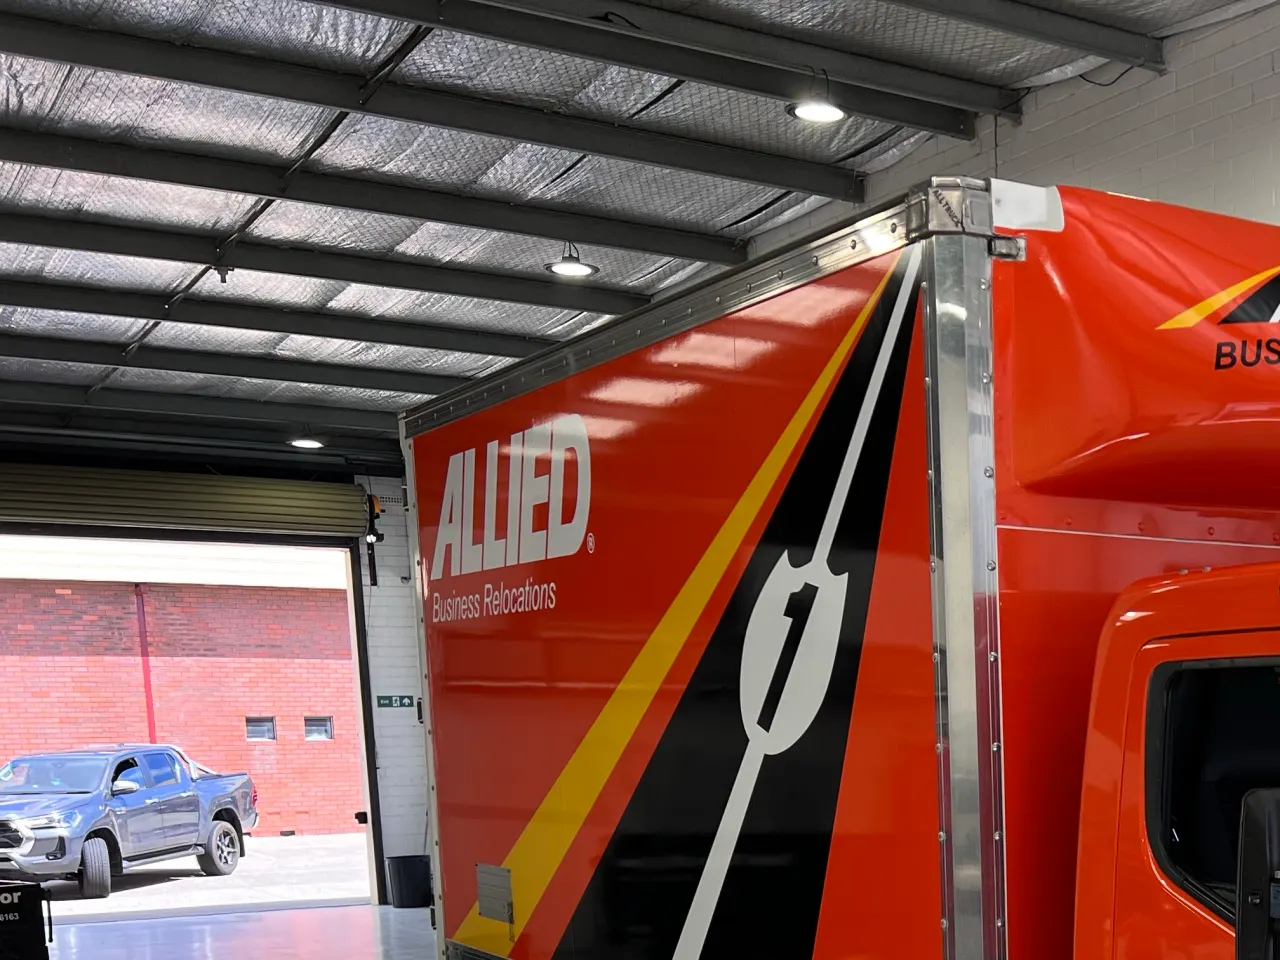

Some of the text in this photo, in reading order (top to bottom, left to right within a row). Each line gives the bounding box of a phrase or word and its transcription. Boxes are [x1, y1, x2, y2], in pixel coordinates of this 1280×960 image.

[430, 413, 592, 581] ALLIED
[432, 577, 557, 623] Business Relocations
